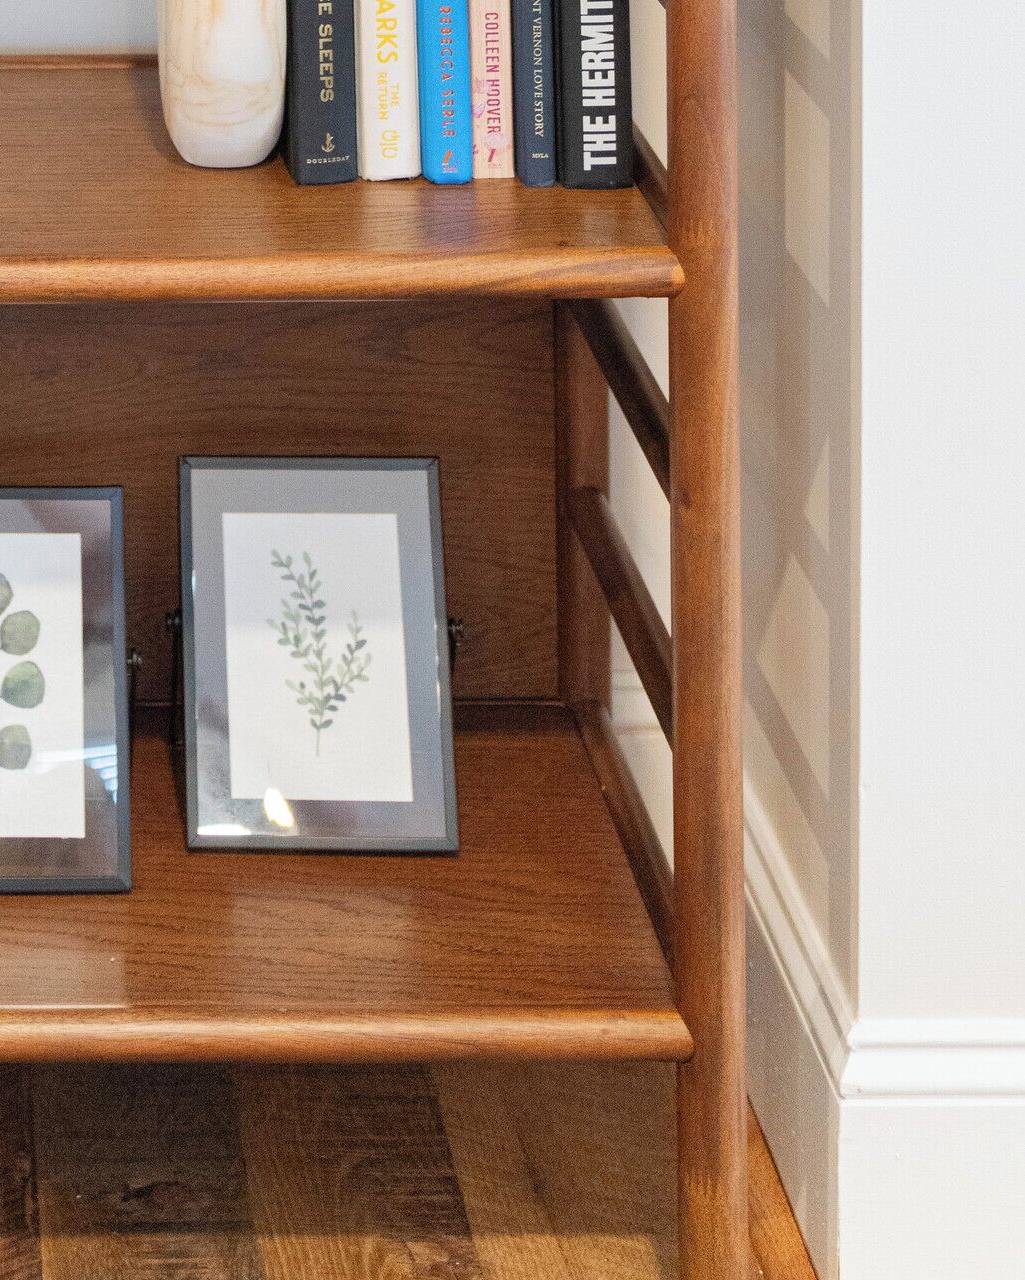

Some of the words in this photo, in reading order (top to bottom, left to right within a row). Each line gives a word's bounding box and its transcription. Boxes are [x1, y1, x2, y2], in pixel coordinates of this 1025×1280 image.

[319, 24, 334, 102] SLEEPS
[439, 6, 453, 81] REBECCA
[485, 12, 499, 72] COLLEEN
[532, 17, 542, 65] VERNON
[378, 72, 389, 120] RETURN
[391, 83, 400, 108] THE
[486, 79, 501, 134] HOOVER
[534, 70, 542, 98] LOVE
[442, 89, 455, 137] SERLE
[534, 101, 544, 137] STORY
[583, 115, 616, 170] THE
